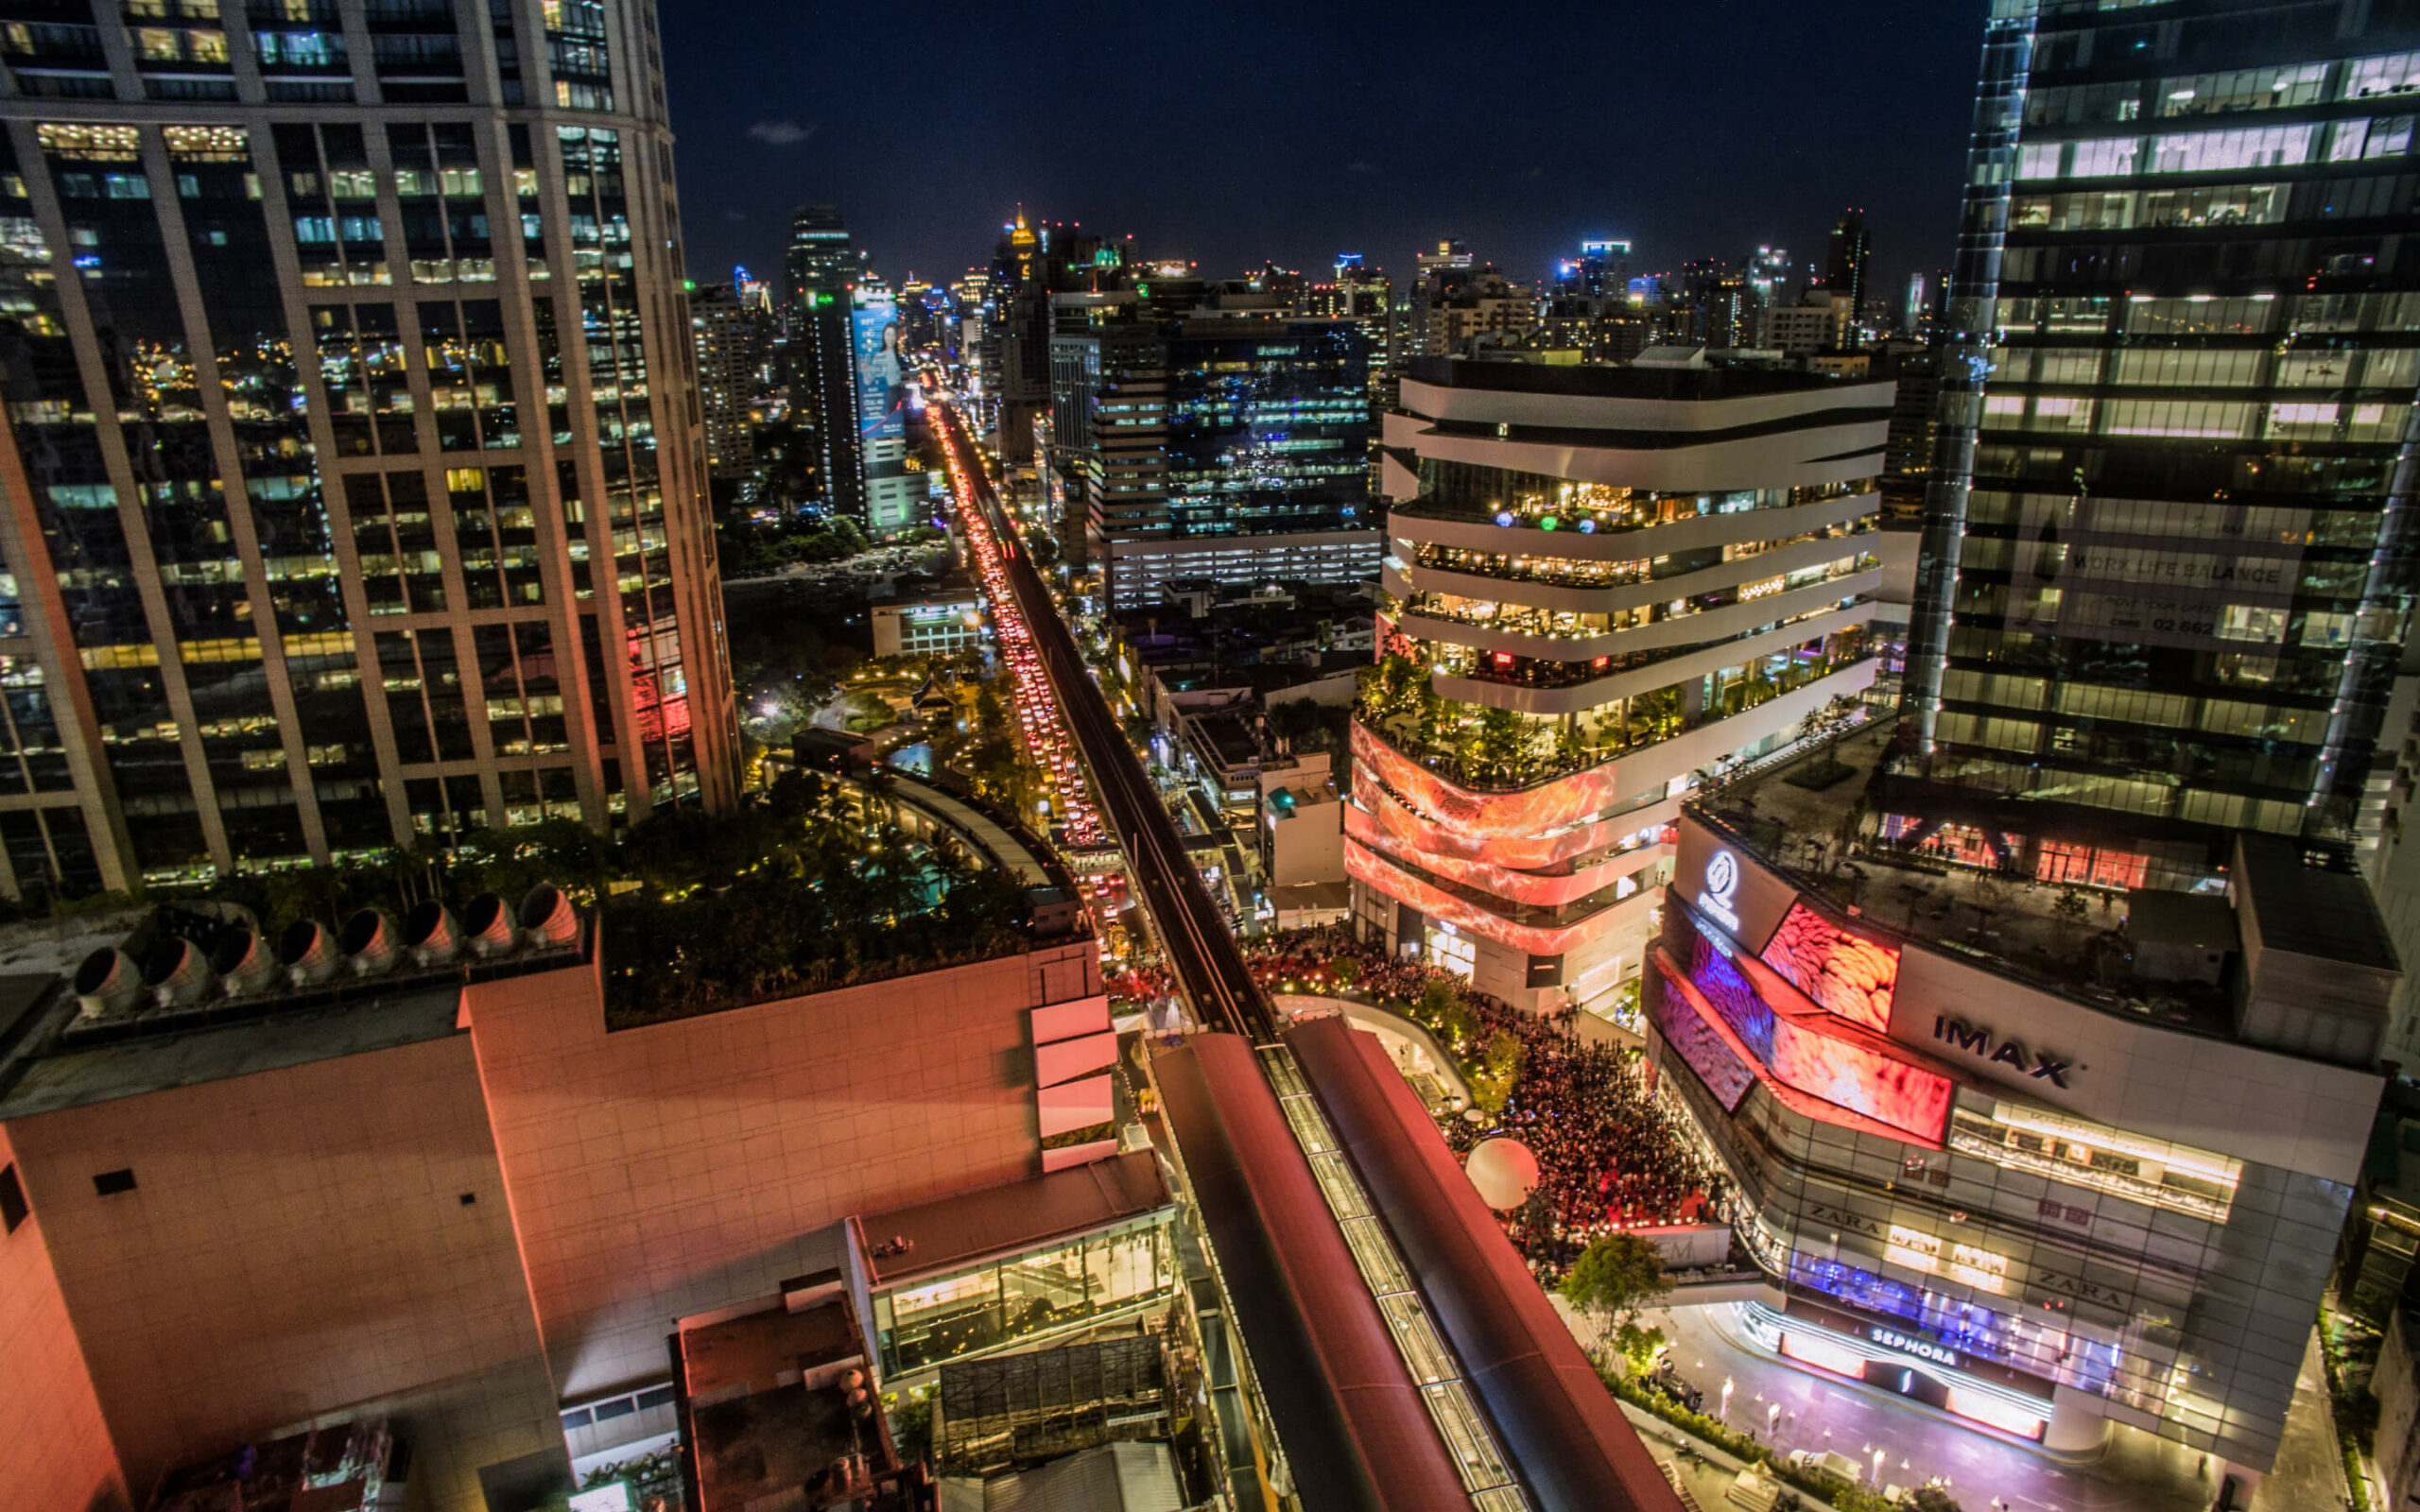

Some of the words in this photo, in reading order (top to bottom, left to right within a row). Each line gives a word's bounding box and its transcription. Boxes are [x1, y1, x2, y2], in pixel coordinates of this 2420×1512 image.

[2073, 555, 2133, 572] WORK
[2137, 558, 2178, 576] LIFE
[2183, 562, 2282, 584] BALANCE
[2152, 618, 2174, 632] 02
[2180, 620, 2214, 636] 662
[1934, 1015, 2070, 1090] IMAX
[1810, 1205, 1880, 1234] ZARA
[2040, 1271, 2122, 1305] ZARA
[1872, 1328, 1956, 1366] SEPHORA
